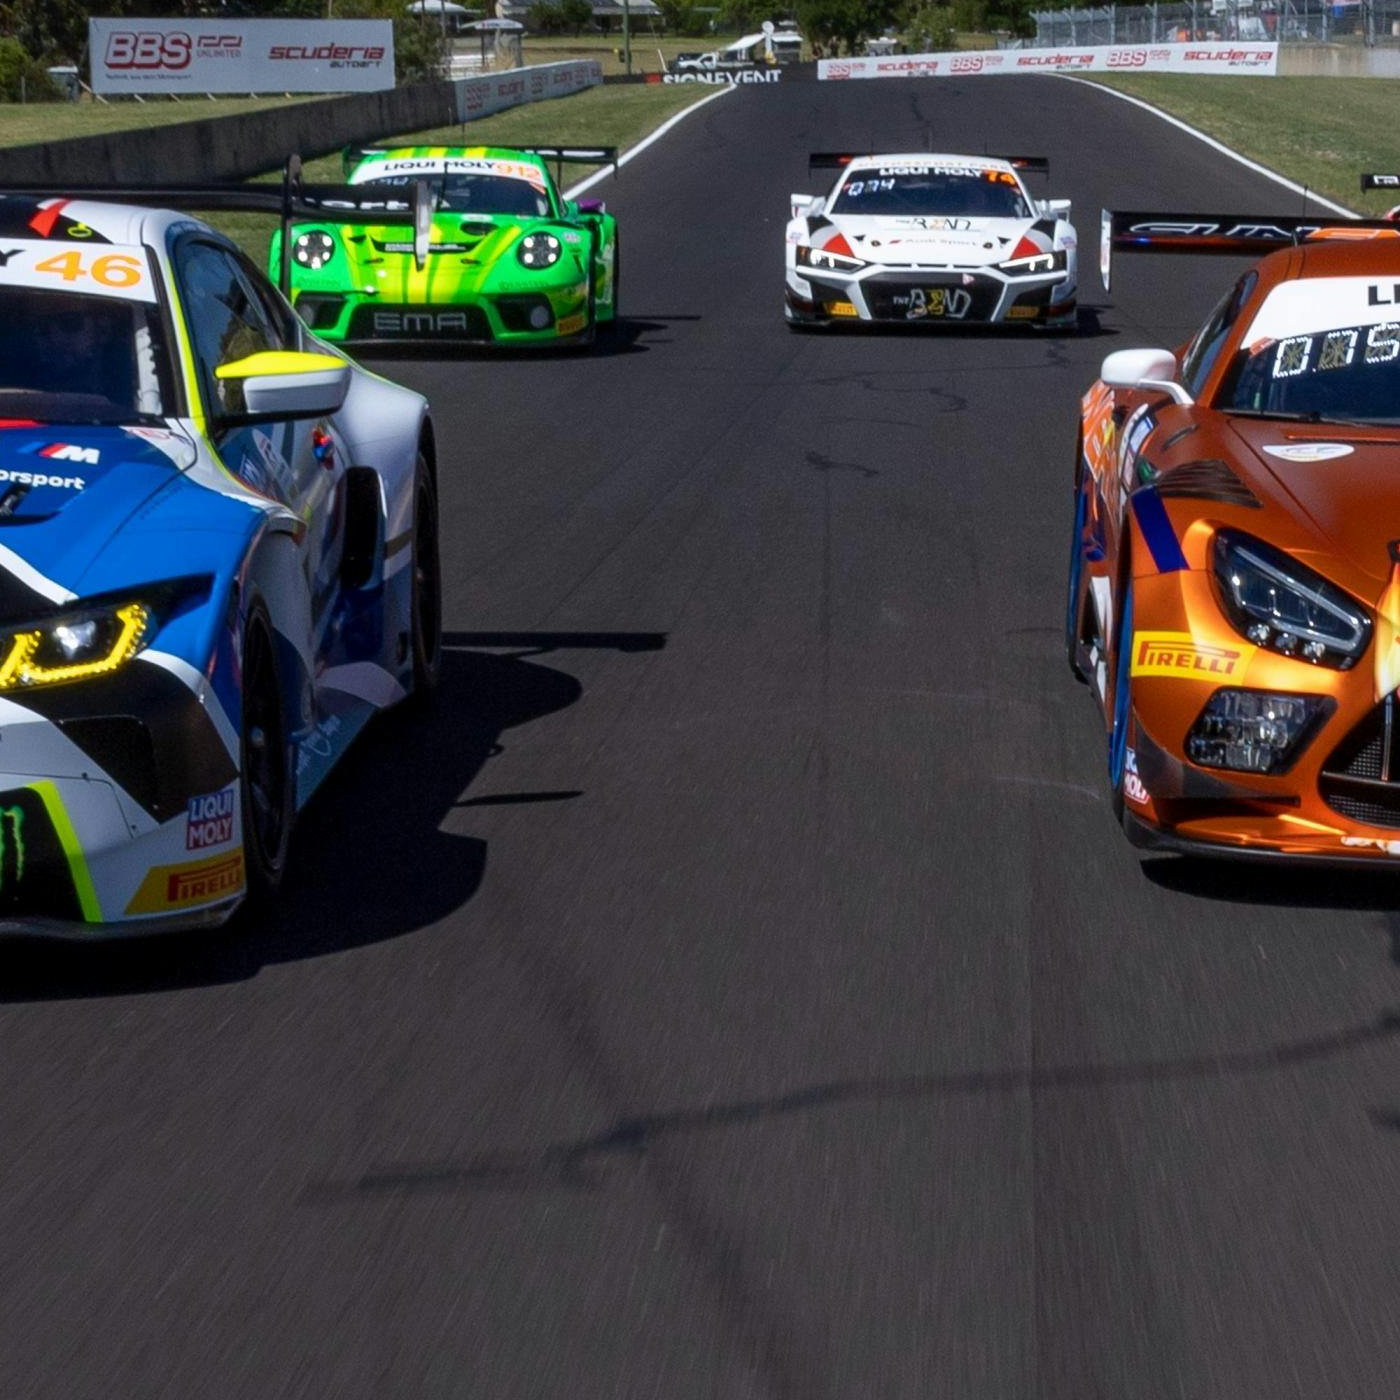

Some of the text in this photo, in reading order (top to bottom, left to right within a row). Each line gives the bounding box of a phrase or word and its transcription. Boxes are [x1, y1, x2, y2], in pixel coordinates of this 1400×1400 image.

[104, 31, 192, 70] BBS
[268, 42, 385, 60] scuderia
[1106, 50, 1147, 68] BBS
[1183, 48, 1274, 61] scuderia
[950, 55, 983, 73] BBS
[1016, 54, 1095, 66] scuderia
[383, 161, 436, 171] LIQUI
[444, 160, 496, 170] MOLY
[879, 167, 930, 177] LIQUI
[934, 167, 983, 178] MOLY
[34, 250, 143, 288] 46
[1137, 640, 1241, 675] PIRELLI
[189, 792, 232, 822] LIQUI
[188, 816, 233, 848] MOLY
